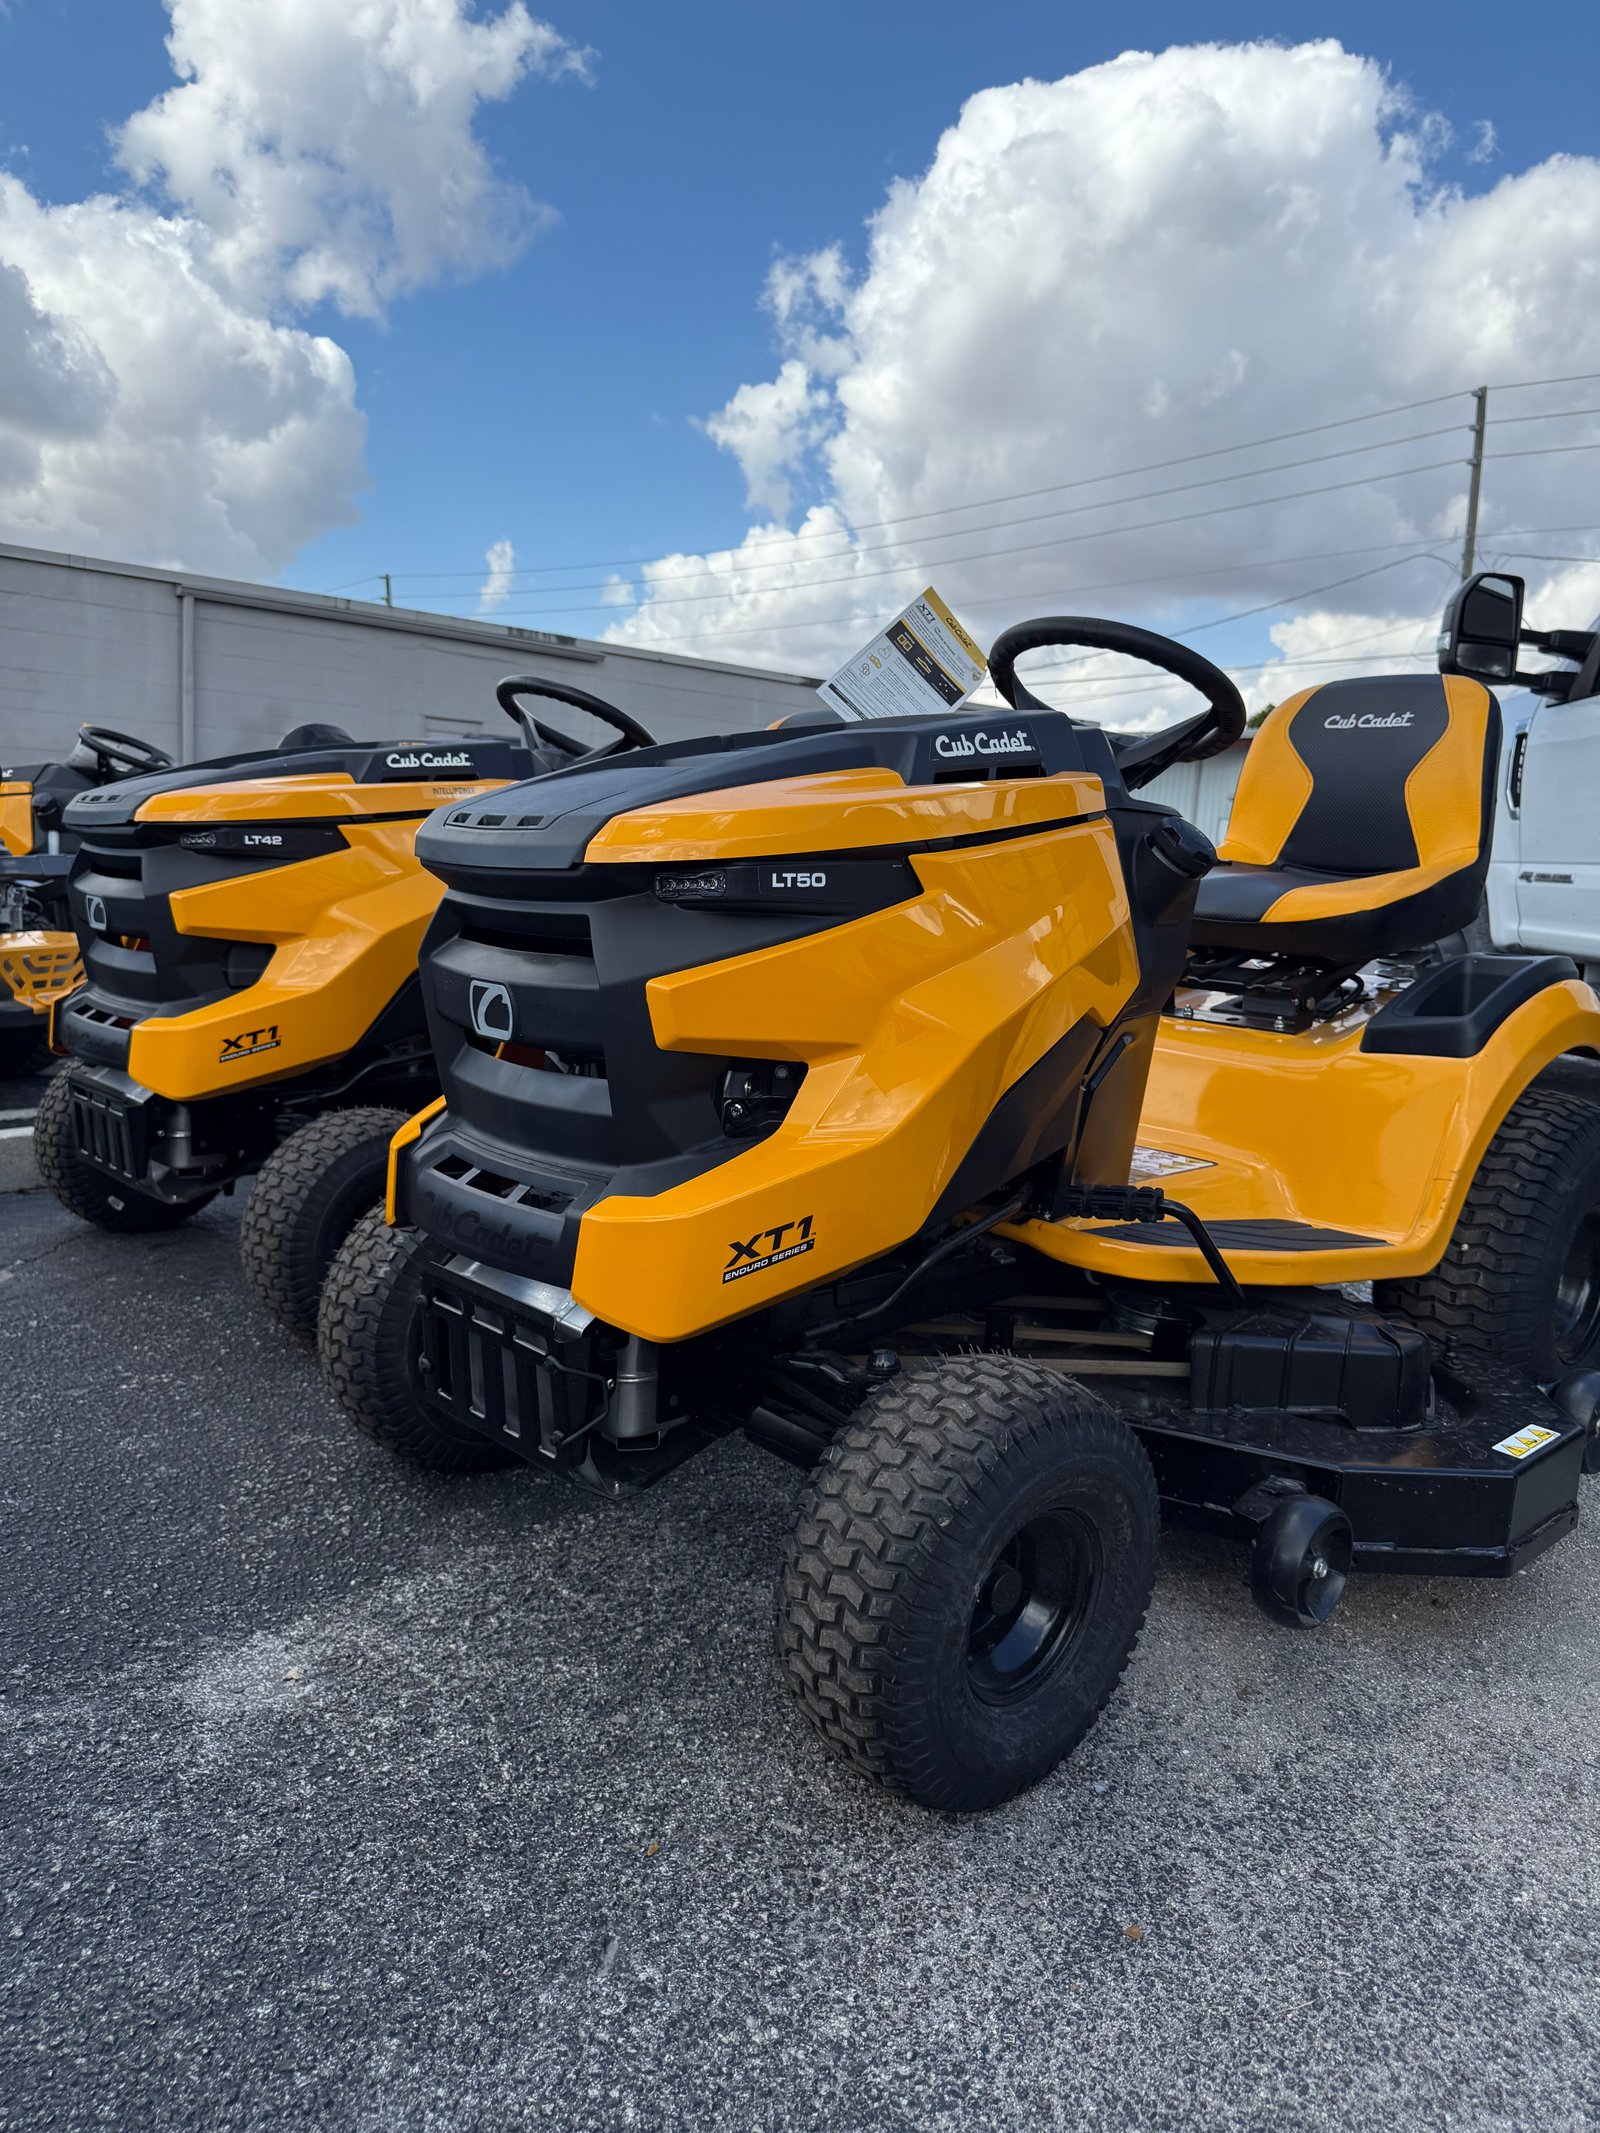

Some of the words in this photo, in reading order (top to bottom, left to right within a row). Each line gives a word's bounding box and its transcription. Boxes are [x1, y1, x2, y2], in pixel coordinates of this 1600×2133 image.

[919, 603, 935, 621] XT1
[1323, 713, 1357, 729] Cub
[1357, 711, 1415, 728] Cadet
[935, 734, 976, 758] Cub
[974, 730, 1033, 754] Cadet
[386, 753, 421, 768] Cub
[420, 752, 471, 767] Cadet
[244, 835, 283, 846] LT42
[772, 872, 827, 888] LT50
[221, 1025, 279, 1054] XT1
[453, 1210, 553, 1267] Cadet
[724, 1214, 814, 1269] XT1
[724, 1259, 769, 1281] ENDURO
[771, 1243, 808, 1263] SERIES
